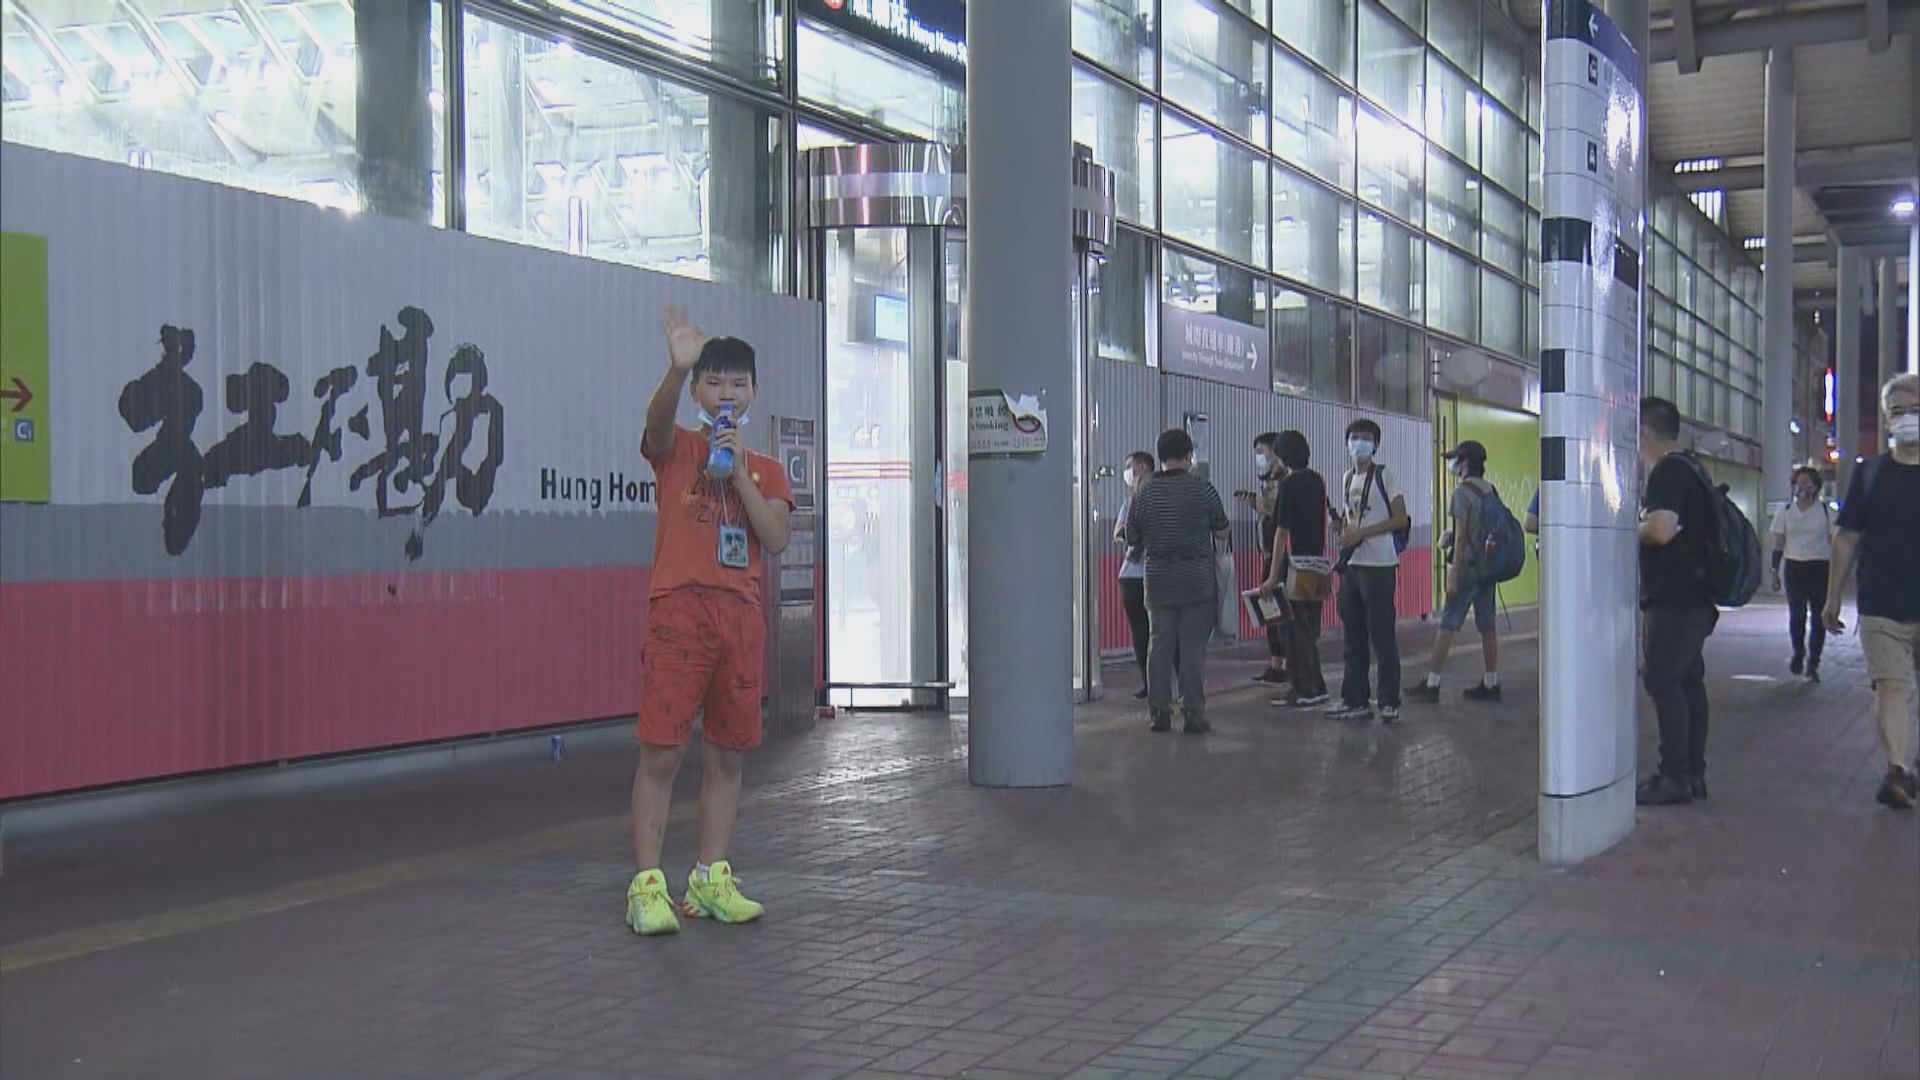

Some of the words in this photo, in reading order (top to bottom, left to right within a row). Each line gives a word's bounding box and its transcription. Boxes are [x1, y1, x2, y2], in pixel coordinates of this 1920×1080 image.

[789, 455, 806, 483] C2
[541, 467, 602, 509] Hung
[609, 471, 657, 503] Hom
